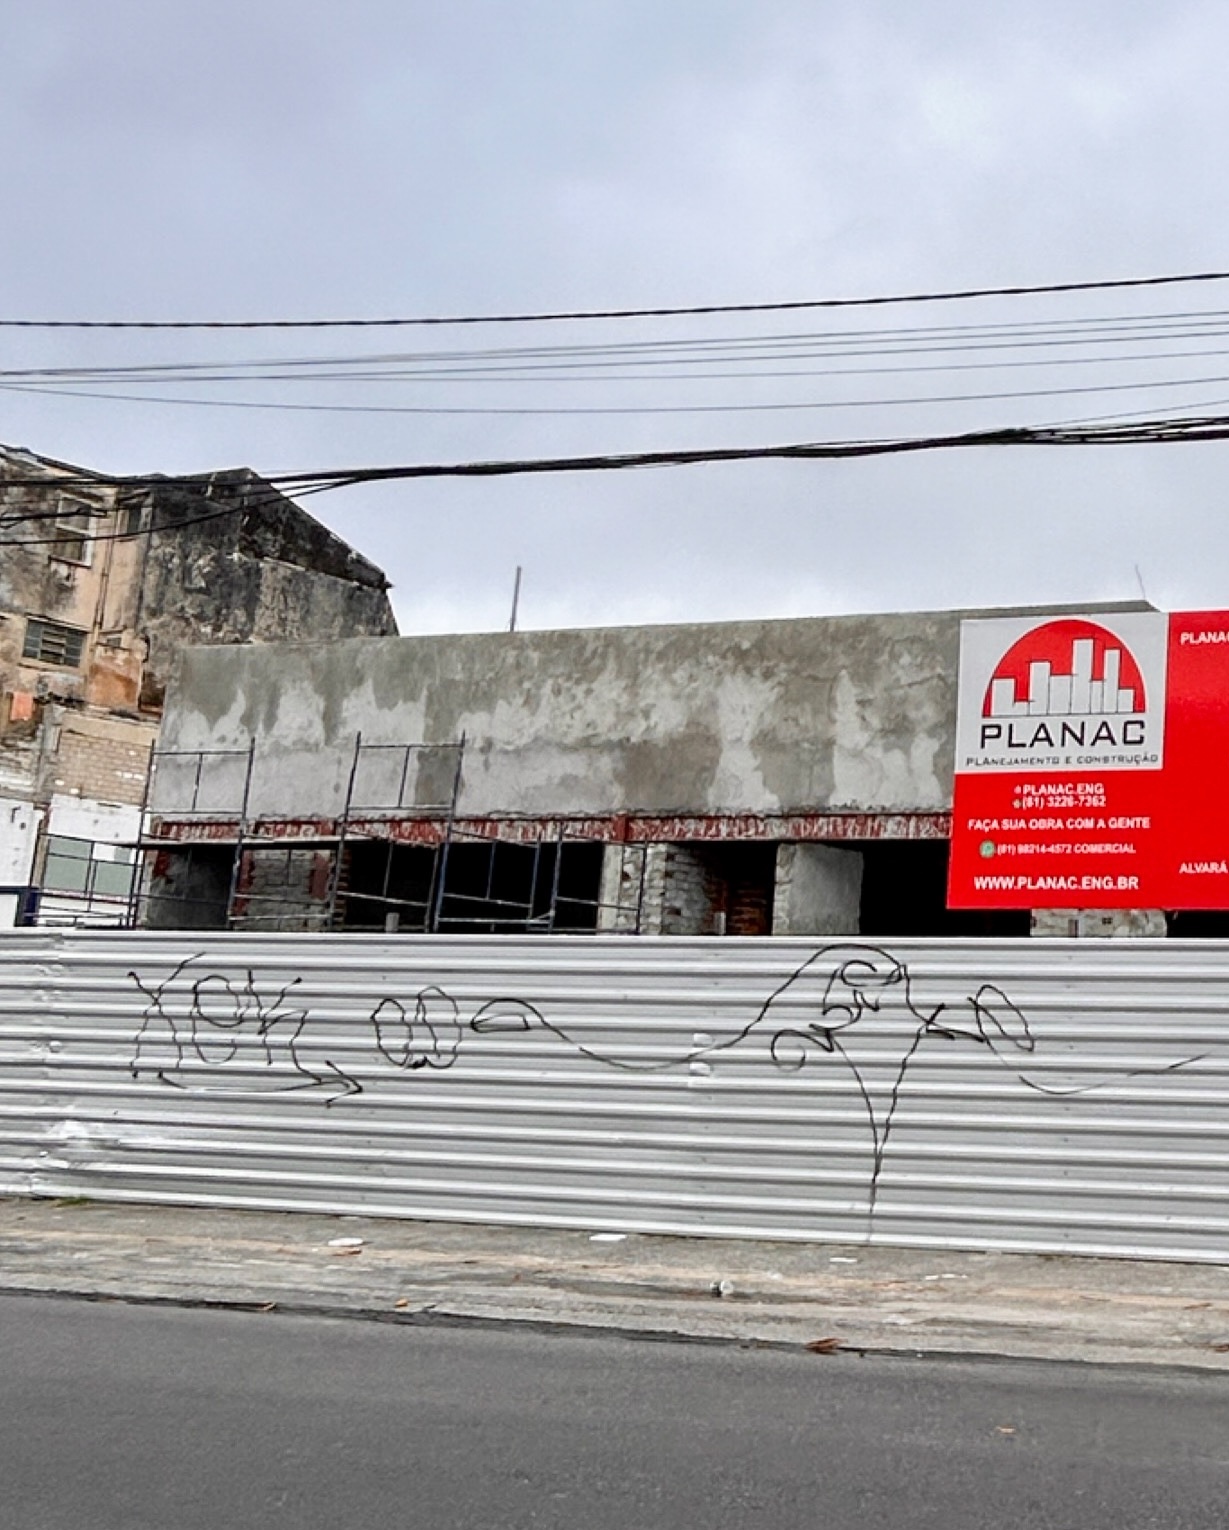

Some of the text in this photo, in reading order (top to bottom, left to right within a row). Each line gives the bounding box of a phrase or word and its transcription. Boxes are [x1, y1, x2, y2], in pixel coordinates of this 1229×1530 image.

[980, 719, 1145, 749] PLANAC
[966, 751, 1159, 766] PLANEJAMENTO E CONSTRUÇÃO
[1023, 783, 1104, 795] PLANAC.ENG
[968, 817, 1149, 832] FAÇA SUA OBRA COM A GENTE
[1074, 843, 1136, 853] COMERCIAL
[1179, 861, 1228, 873] ALVARÁ
[974, 876, 1138, 889] WWW.PLANAC.ENG.BR
